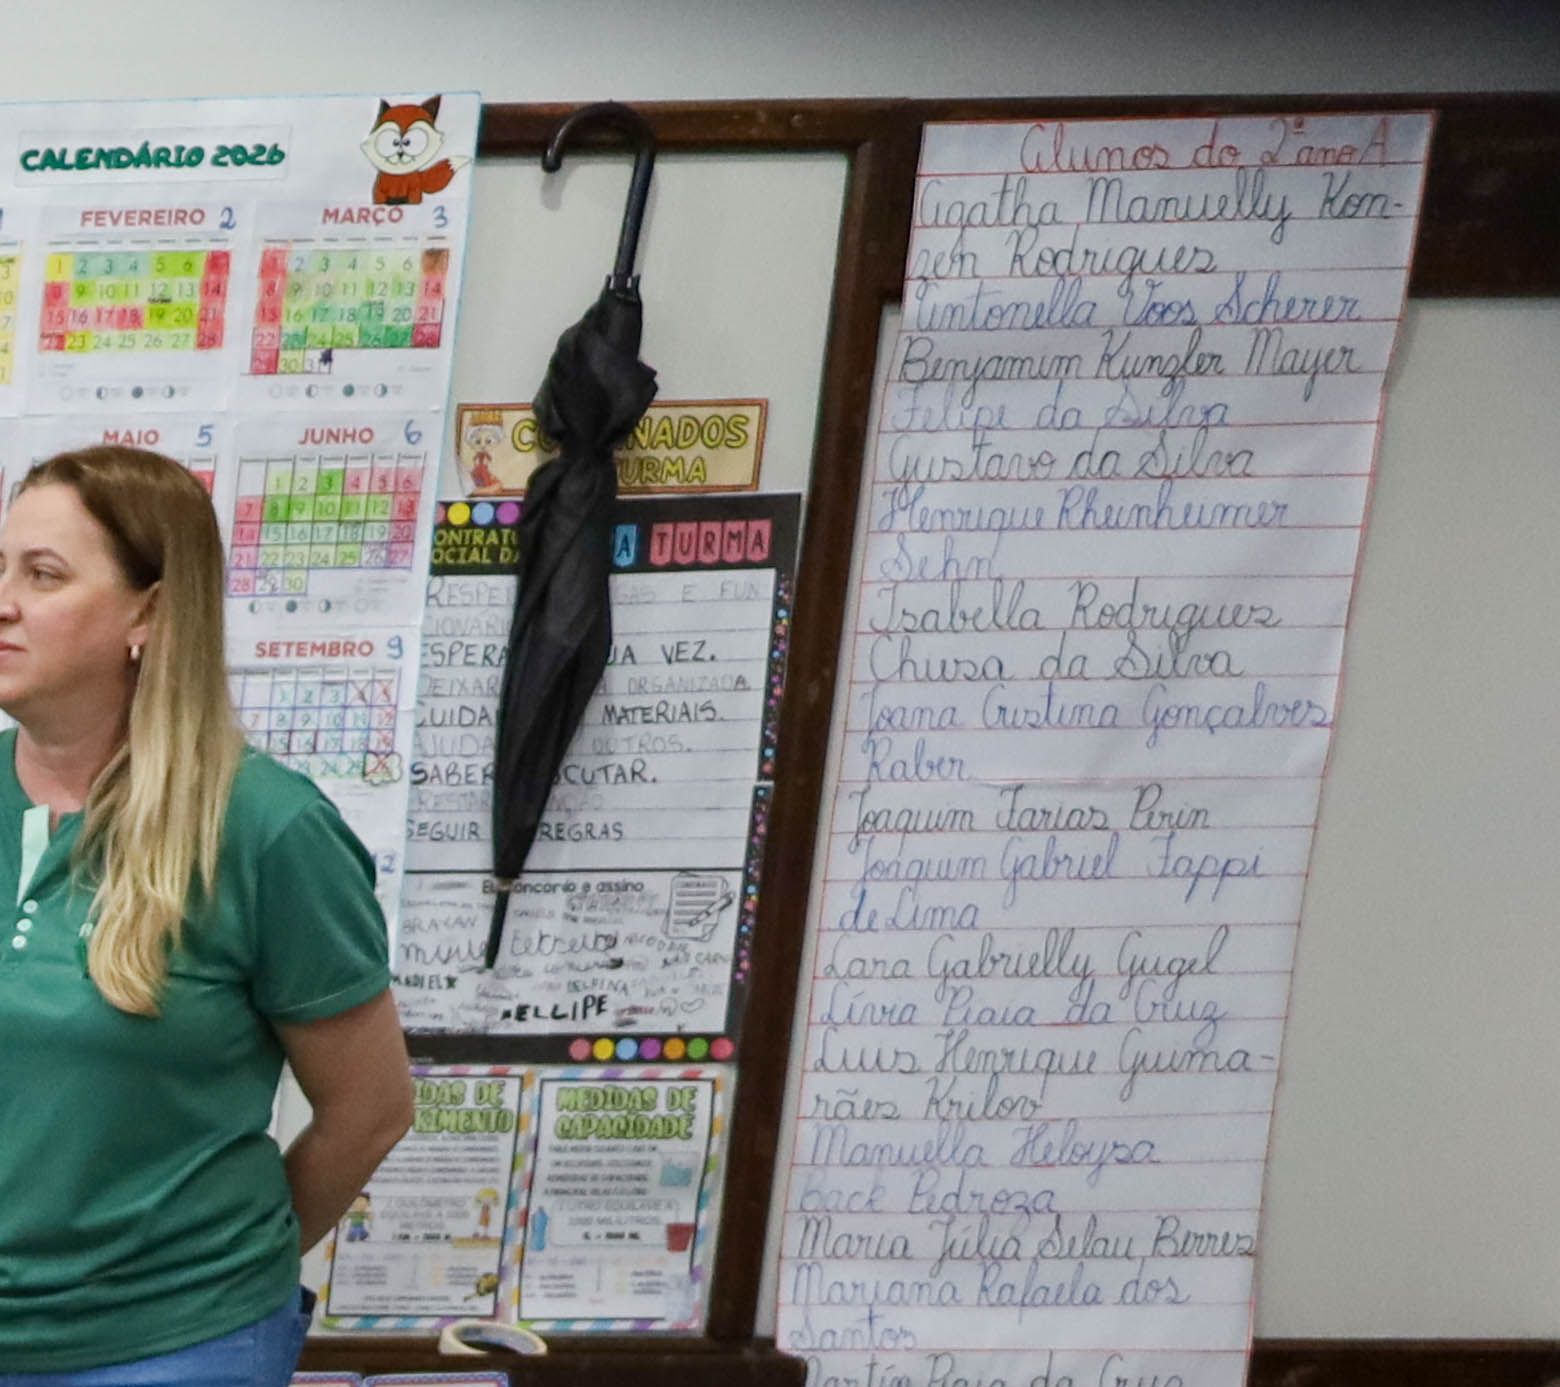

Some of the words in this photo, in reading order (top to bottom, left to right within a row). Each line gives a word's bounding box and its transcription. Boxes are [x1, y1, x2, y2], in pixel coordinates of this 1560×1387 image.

[21, 142, 202, 171] CALENDÁRIO
[211, 144, 285, 167] 2026
[1021, 121, 1169, 172] Alunos
[1189, 117, 1240, 168] do
[1294, 139, 1358, 167] ano
[1358, 117, 1391, 168] A
[80, 207, 205, 228] FEVEREIRO
[219, 207, 237, 230] 2
[321, 205, 404, 226] MARÇO
[432, 207, 449, 229] 3
[916, 174, 1062, 229] Agatha
[1087, 165, 1292, 244] Manuelly
[1008, 224, 1218, 294] Rodrigues
[915, 267, 1097, 331] Antonella
[1214, 263, 1362, 323] Scherer
[1245, 328, 1362, 402] Mayer
[890, 385, 1010, 433] Felipe
[1036, 379, 1083, 429] da
[1103, 383, 1230, 428] Silva
[102, 429, 160, 446] MAIO
[195, 423, 214, 448] 5
[298, 427, 374, 446] JUNHO
[403, 420, 422, 446] 6
[889, 437, 1057, 509] Gustavo
[1069, 432, 1120, 481] da
[1135, 428, 1256, 479] Silva
[655, 529, 766, 558] TURMA
[877, 486, 1046, 558] Henrique
[869, 577, 1046, 632] Isabella
[1067, 577, 1284, 640] Rodrigues
[254, 640, 374, 659] SETEMBRO
[386, 636, 404, 660] 9
[661, 640, 716, 665] VEZ.
[1038, 632, 1090, 681] da
[1112, 632, 1247, 681] Silva
[860, 688, 959, 751] Joana
[982, 680, 1120, 729] Cristina
[1141, 680, 1333, 749] Gonçalves
[847, 784, 975, 853] Joaquim
[1126, 783, 1210, 830] Perin
[856, 835, 988, 895] Joaquim
[1000, 832, 1120, 910] Gabriel
[839, 888, 879, 932] de
[887, 893, 980, 931] Lima
[823, 934, 916, 979] Lara
[927, 927, 1095, 999] Gabrielly
[1117, 924, 1230, 999] Gugel
[1062, 974, 1115, 1026] da
[1134, 979, 1230, 1046] Cruz
[933, 1027, 1097, 1100] Henrique
[557, 1087, 657, 1113] MEDIDAS
[666, 1087, 696, 1112] DE
[555, 1112, 693, 1141] CAPACIDADE
[809, 1119, 988, 1168] Manuella
[1009, 1119, 1161, 1185] Heloysa
[798, 1215, 914, 1260] Maria
[929, 1214, 1024, 1277] Júlia
[792, 1262, 962, 1307] Mariana
[975, 1261, 1104, 1326] Rafaela
[1119, 1259, 1190, 1306] dos
[789, 1306, 920, 1351] Santos
